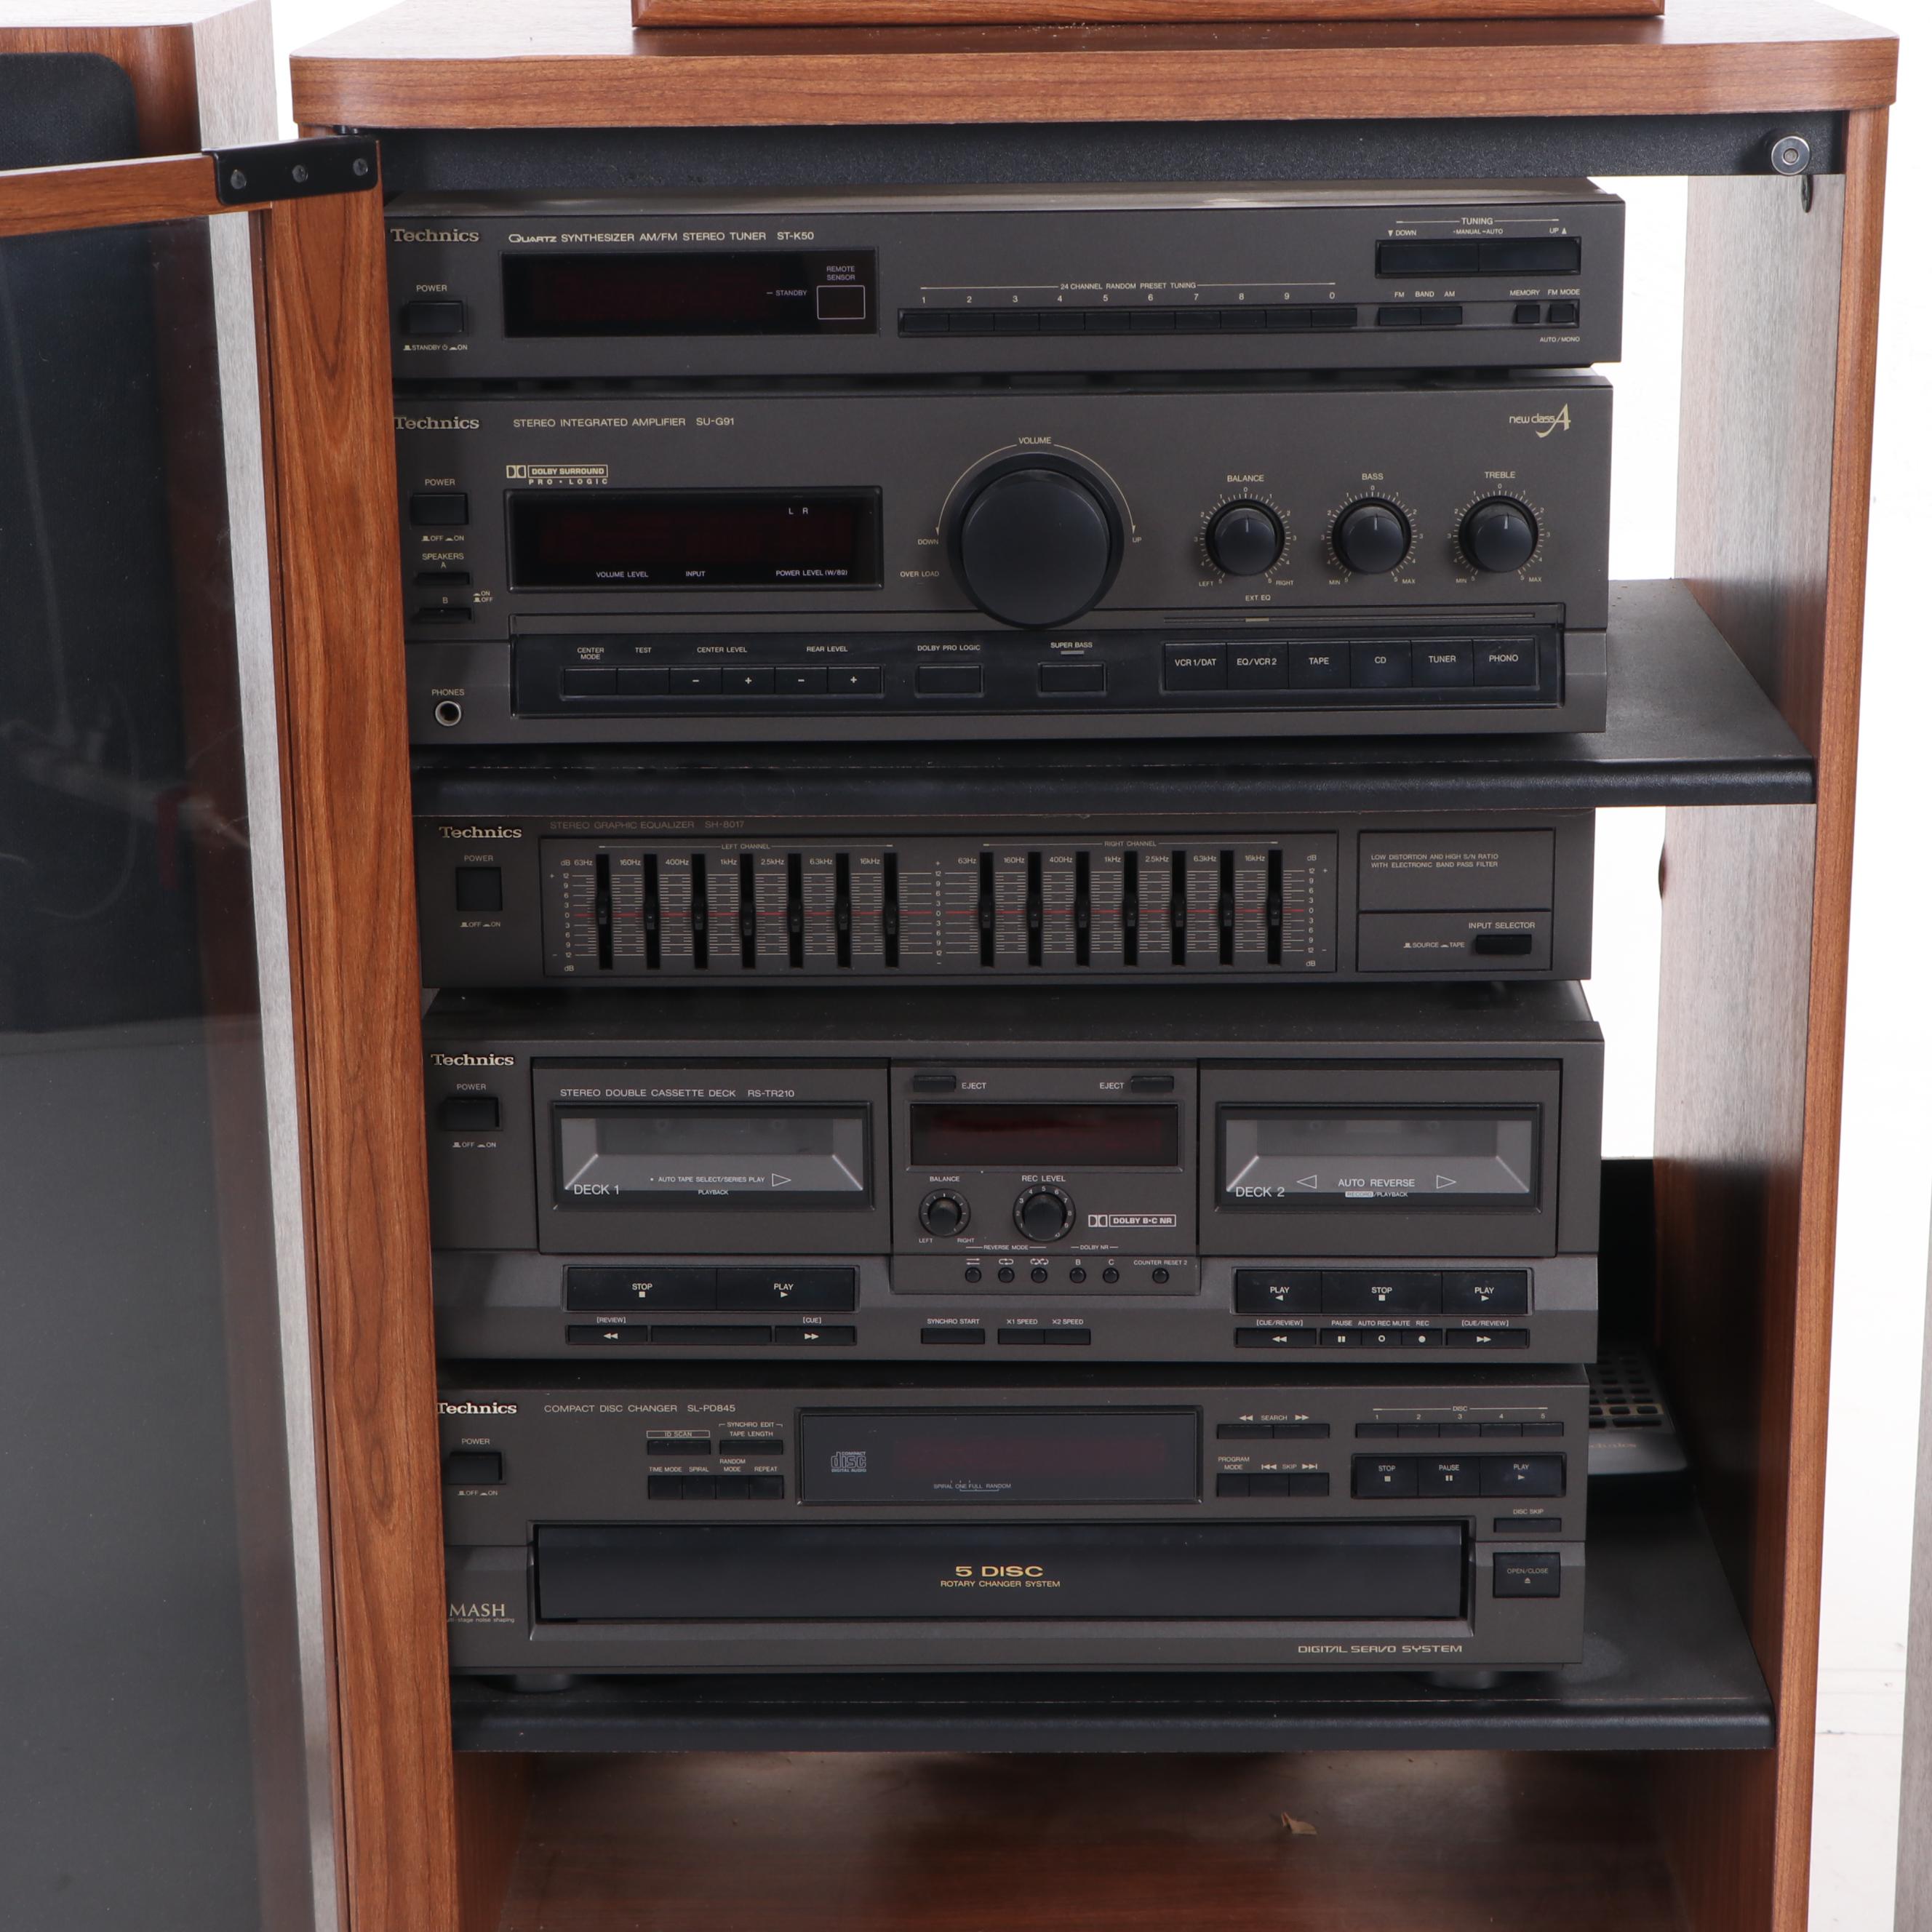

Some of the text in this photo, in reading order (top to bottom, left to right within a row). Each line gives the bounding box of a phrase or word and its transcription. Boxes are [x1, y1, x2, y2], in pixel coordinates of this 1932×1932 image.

[391, 229, 479, 242] Technics
[562, 233, 634, 242] SYNTHESIZER
[640, 233, 677, 241] AM/FM
[683, 232, 724, 241] STEREO
[730, 232, 766, 240] TUNER
[778, 232, 814, 240] ST-K50
[394, 417, 479, 429] Technics
[514, 417, 733, 428] STEREO INTEGRATED AMPLIFIER SU-G91
[641, 821, 694, 829] EQUALIZER
[439, 826, 522, 838] Technics
[431, 1053, 514, 1066] Technics
[651, 1089, 704, 1097] CASSETTE
[573, 1184, 618, 1195] DECK 1
[1236, 1186, 1285, 1198] DECK 2
[436, 1402, 517, 1414] Technics
[956, 1566, 1042, 1577] 5 DISC
[450, 1604, 504, 1616] MASH
